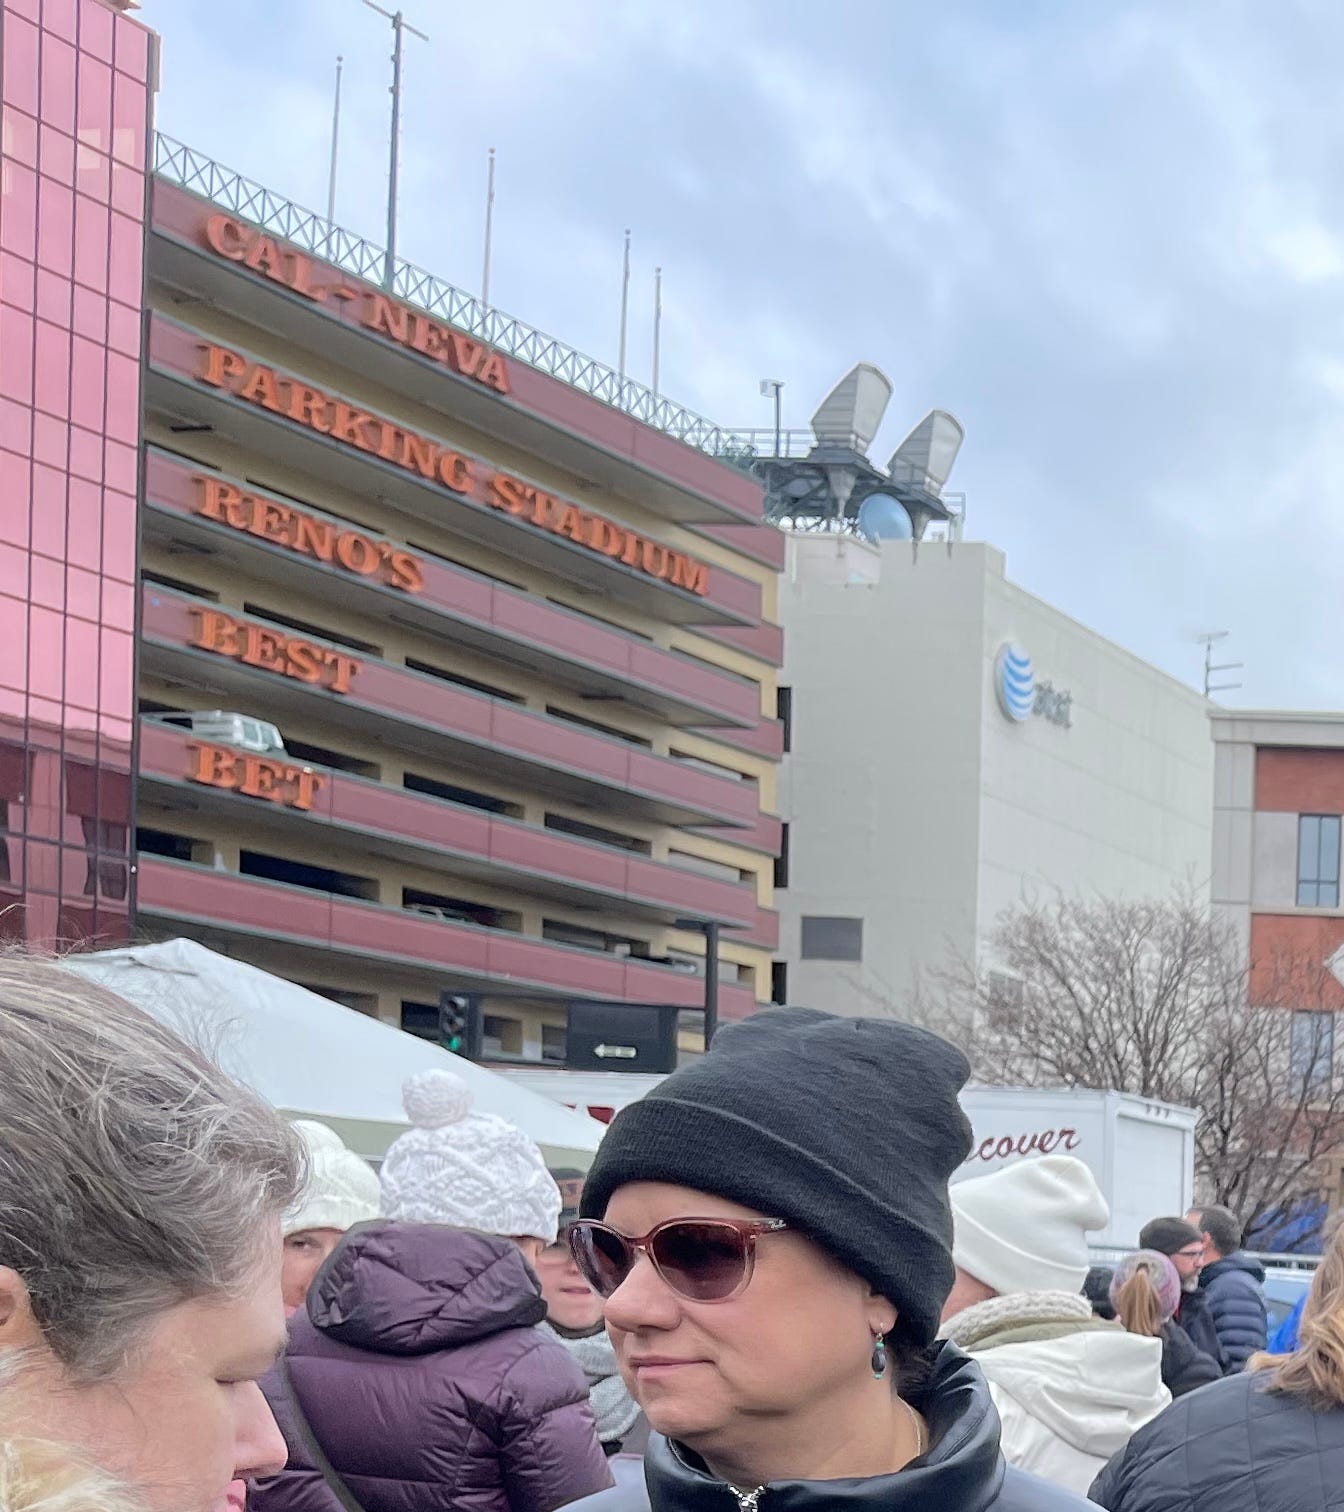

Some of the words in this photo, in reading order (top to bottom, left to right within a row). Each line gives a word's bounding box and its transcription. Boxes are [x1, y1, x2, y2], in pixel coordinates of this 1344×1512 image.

[206, 211, 512, 396] CAL-NEVA
[196, 342, 474, 496] PARKING
[486, 473, 711, 597] STADIUM
[192, 476, 426, 594] RENO'S
[190, 607, 363, 695] BEST
[187, 739, 326, 812] BET
[967, 1127, 1082, 1161] cover
